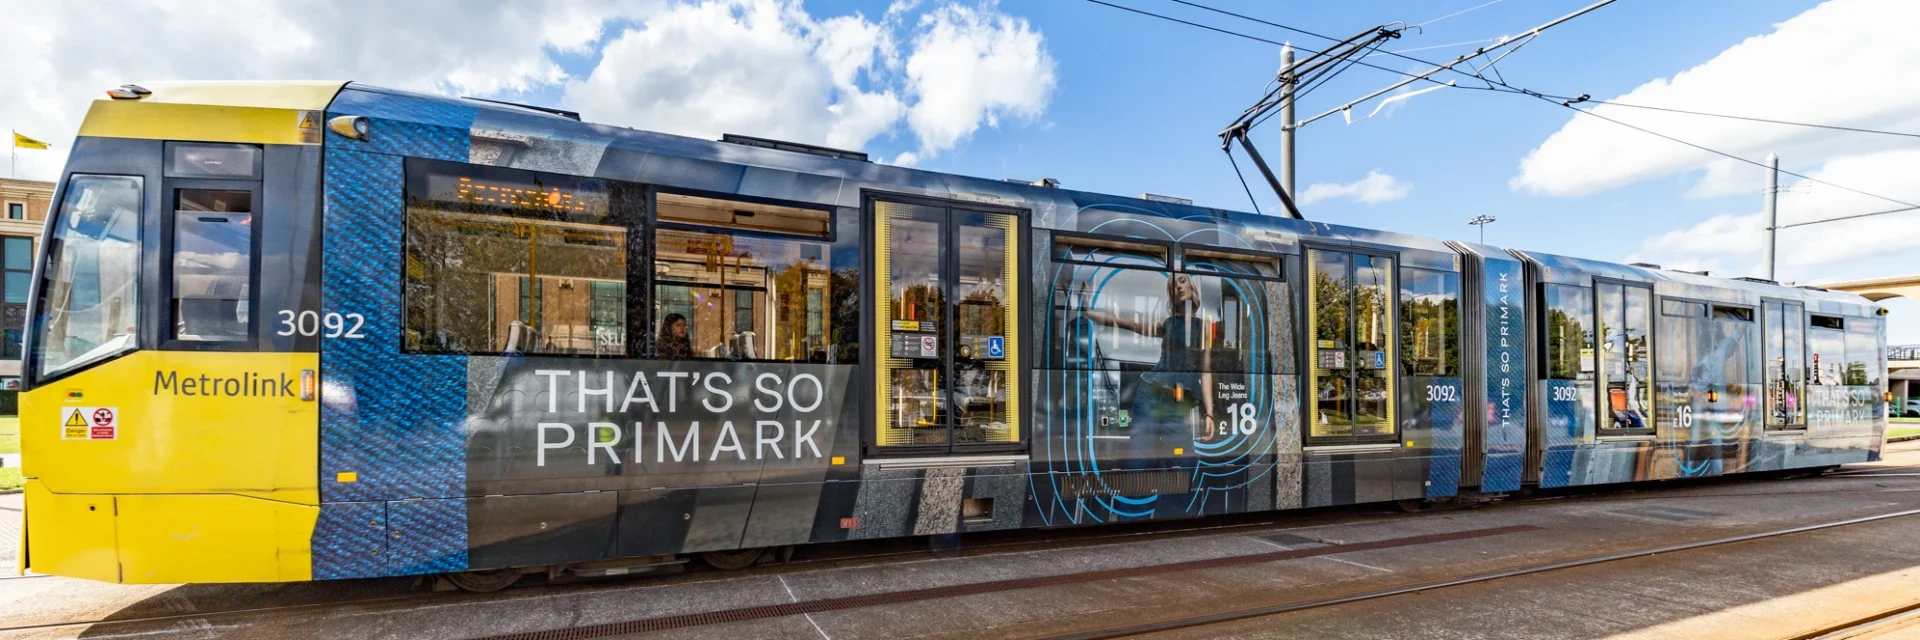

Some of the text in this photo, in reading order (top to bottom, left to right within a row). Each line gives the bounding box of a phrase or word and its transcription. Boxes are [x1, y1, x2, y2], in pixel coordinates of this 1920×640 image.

[276, 309, 365, 339] 3092
[1500, 272, 1510, 428] THAT'S SO PRIMARK
[153, 370, 295, 398] Metrolink
[535, 369, 823, 413] THAT'S SO
[1218, 391, 1248, 401] Leg Jeans
[1426, 385, 1455, 402] 3092
[1553, 386, 1577, 401] 3092
[1816, 389, 1865, 407] THAT'S SO
[1219, 402, 1257, 435] £18
[1816, 409, 1866, 427] PRIMARK
[536, 420, 823, 467] PRIMARK
